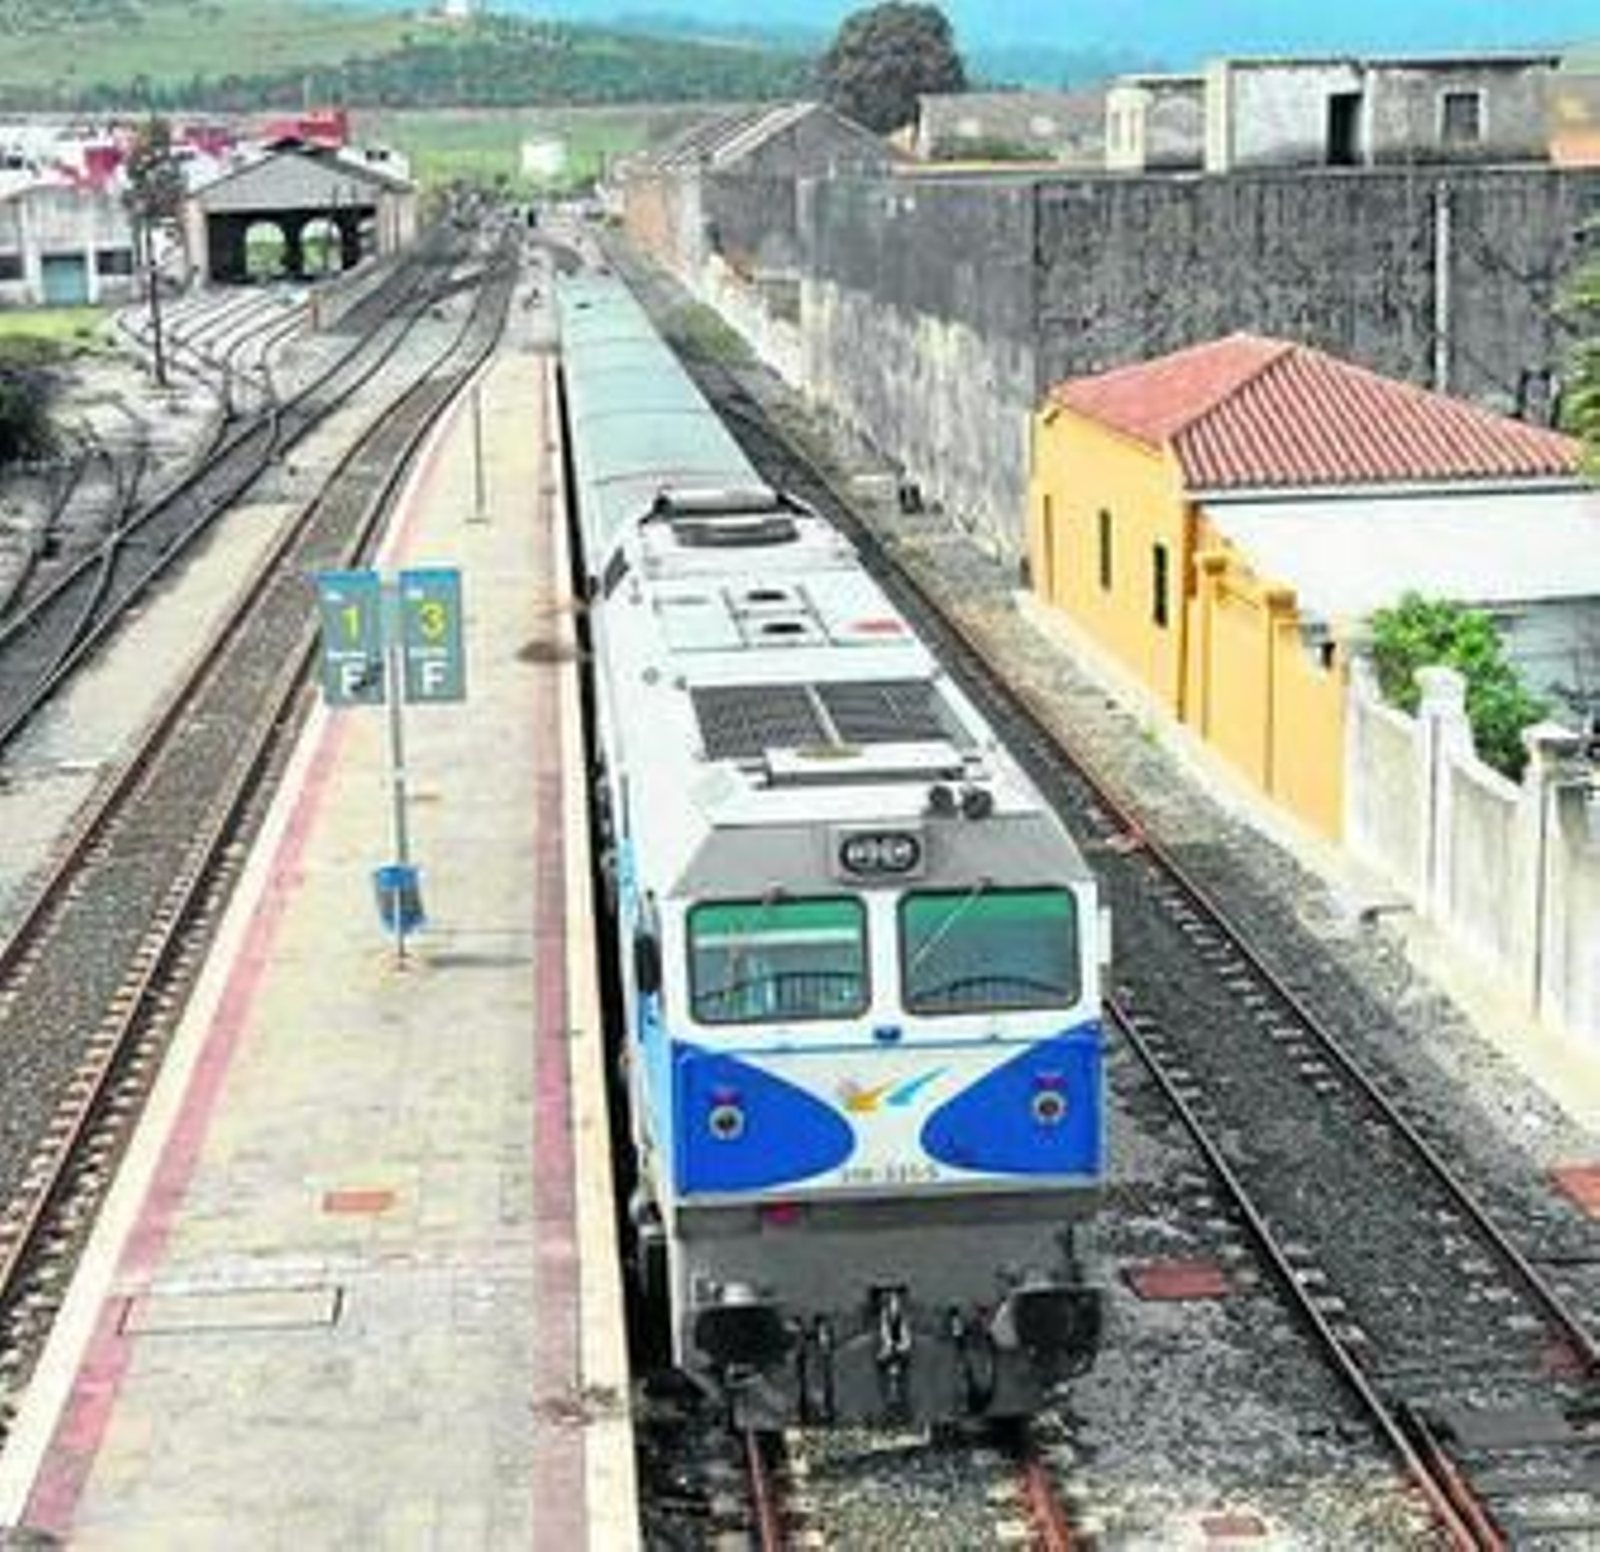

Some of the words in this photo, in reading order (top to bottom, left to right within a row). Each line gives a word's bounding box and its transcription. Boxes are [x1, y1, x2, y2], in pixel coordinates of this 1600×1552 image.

[342, 604, 359, 642] 1
[421, 601, 444, 641] 3
[341, 660, 366, 696] F
[422, 660, 448, 696] F
